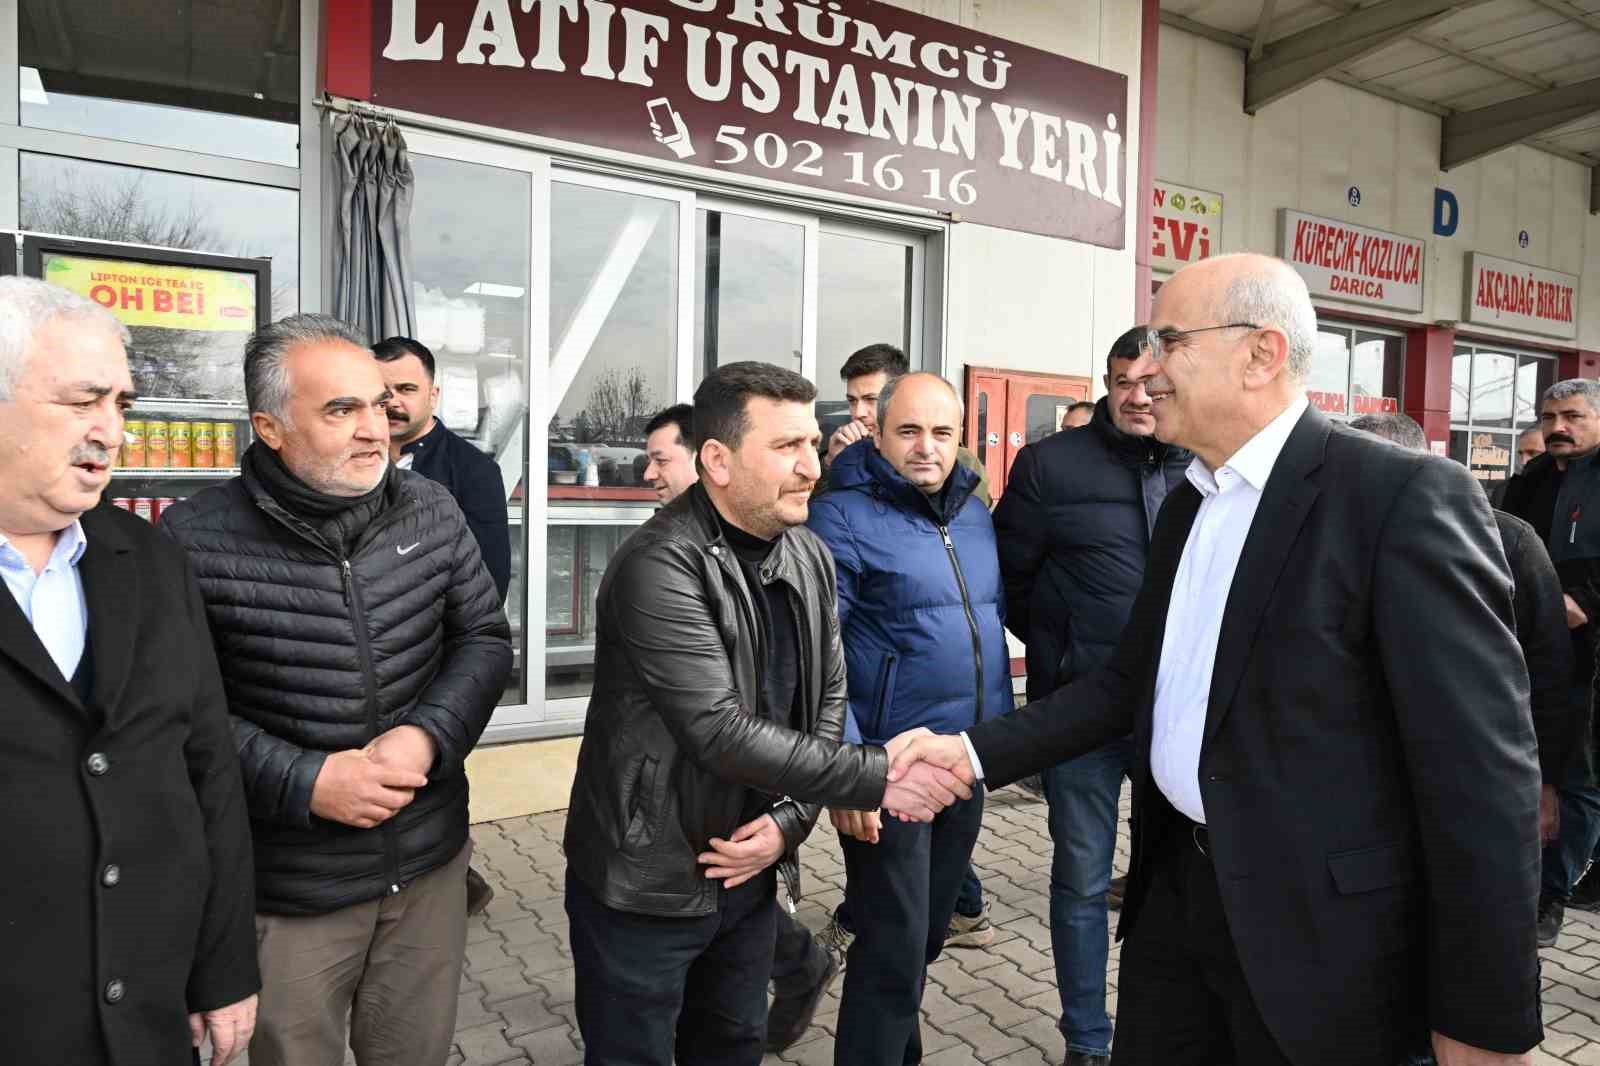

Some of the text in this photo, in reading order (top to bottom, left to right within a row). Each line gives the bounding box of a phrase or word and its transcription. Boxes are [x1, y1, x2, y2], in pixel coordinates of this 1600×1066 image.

[683, 23, 982, 160] USTANIN
[991, 101, 1122, 208] YERİ
[714, 124, 978, 205] 502 16 16
[1433, 187, 1459, 237] D
[90, 271, 137, 285] LIPTON
[1329, 274, 1384, 300] DARICA
[89, 284, 144, 311] OH
[153, 289, 205, 315] BE!
